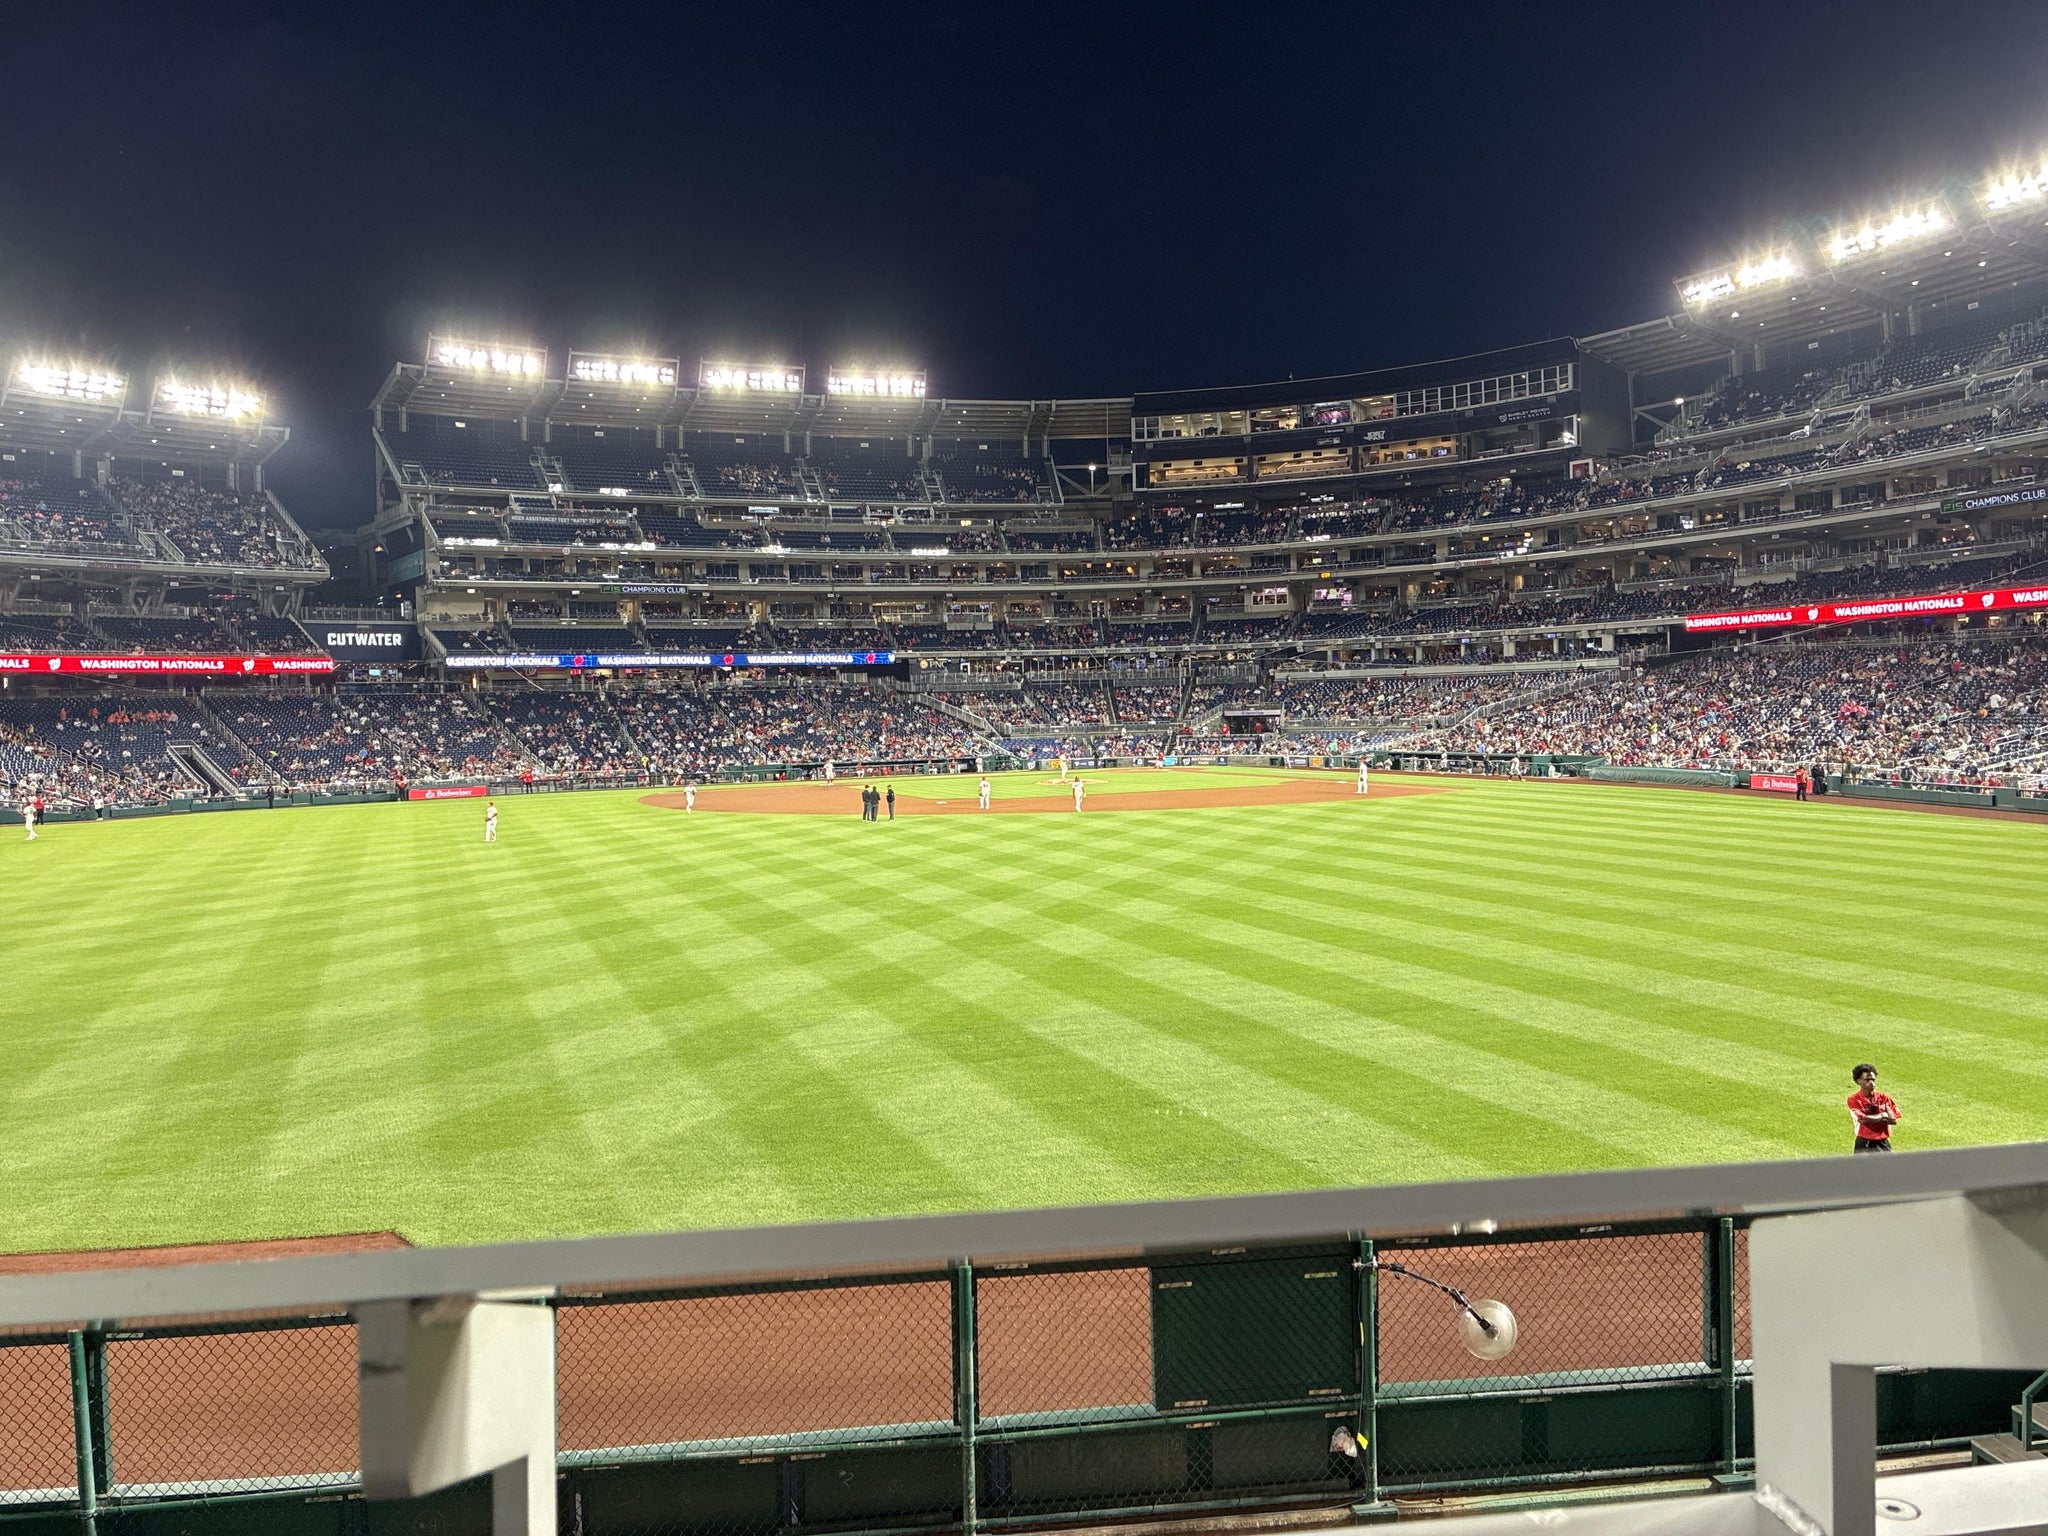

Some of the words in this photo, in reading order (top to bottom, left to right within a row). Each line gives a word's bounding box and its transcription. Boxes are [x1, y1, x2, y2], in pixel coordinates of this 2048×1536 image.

[1965, 493, 2019, 509] CHAMPIONS
[2021, 489, 2046, 500] CLUB
[1742, 612, 1793, 624] NATIONALS
[1835, 605, 1903, 617] WASHINGTON
[1904, 597, 1964, 611] NATIONALS
[327, 632, 402, 646] CUTWATER
[506, 657, 560, 666] NATIONALS
[598, 656, 659, 665] WASHINGTON
[660, 655, 711, 664] NATIONALS
[747, 655, 804, 663] WASHINGTON
[806, 654, 854, 663] NATIONALS
[1236, 652, 1256, 660] PNC
[80, 659, 160, 669] WASHINGTON
[161, 660, 225, 670] NATIONALS
[929, 661, 948, 669] PNC
[1771, 779, 1798, 789] Budweise
[437, 789, 472, 797] Budweiser
